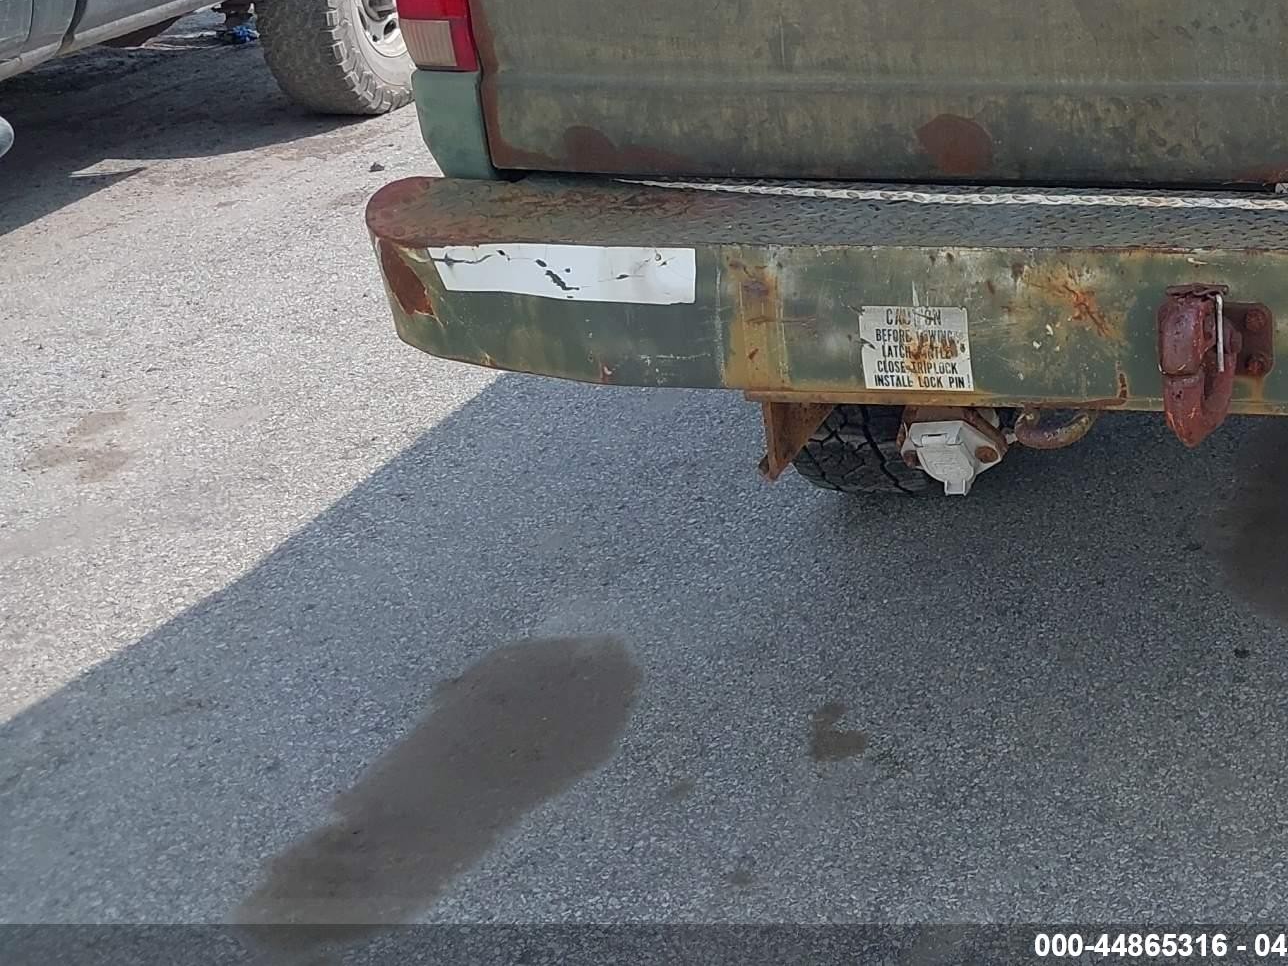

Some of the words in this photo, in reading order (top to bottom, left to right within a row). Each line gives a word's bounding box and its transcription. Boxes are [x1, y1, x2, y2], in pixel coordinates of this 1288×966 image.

[886, 307, 942, 326] CAUON
[876, 328, 912, 343] BEFORE
[881, 345, 911, 359] LATCH
[917, 345, 953, 360] NTLE
[877, 360, 906, 373] CLOSE
[874, 374, 912, 388] INSTALL
[918, 376, 944, 388] LOCK
